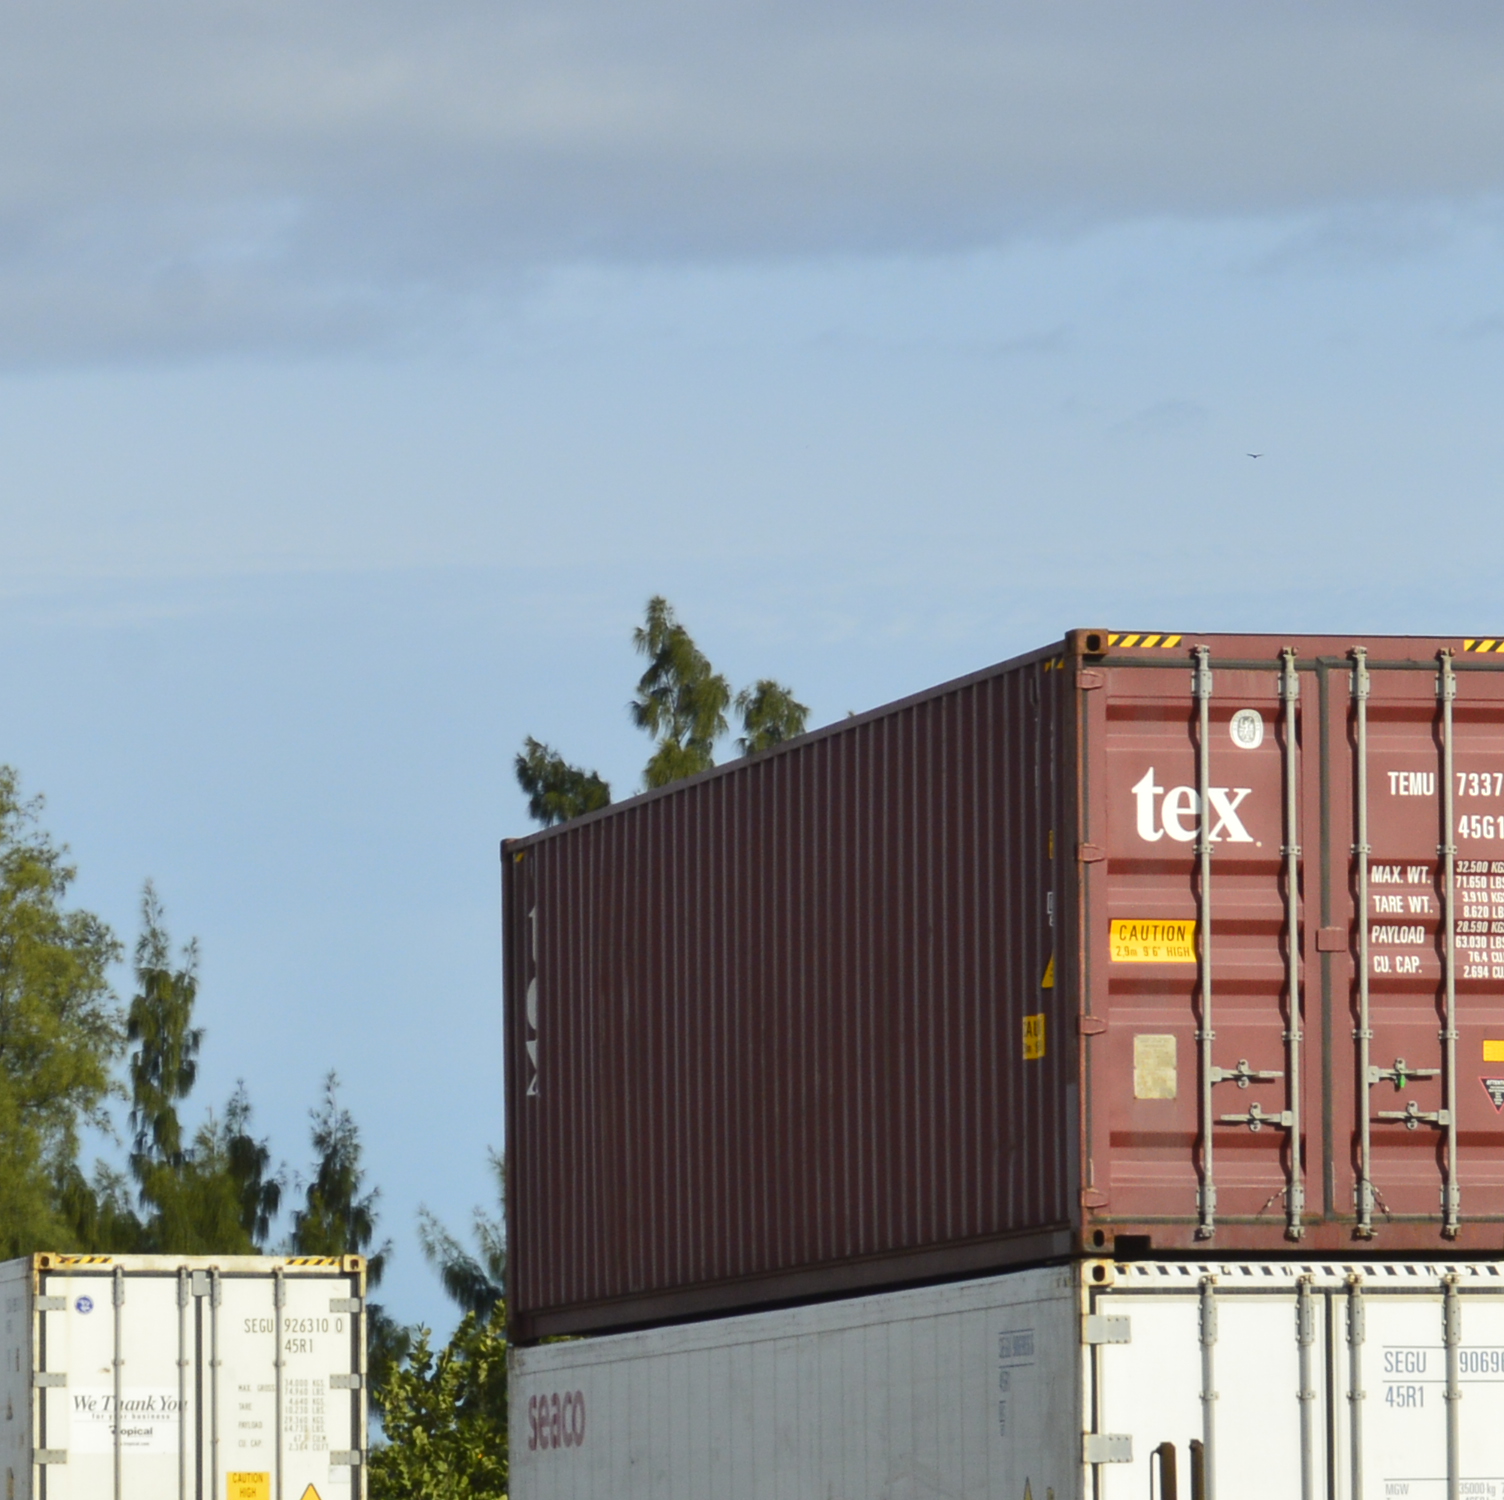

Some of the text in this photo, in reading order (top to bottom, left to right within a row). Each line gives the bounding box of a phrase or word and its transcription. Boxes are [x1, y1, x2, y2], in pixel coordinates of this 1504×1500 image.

[1387, 771, 1435, 796] TEMU
[1131, 766, 1254, 842] tex
[1371, 865, 1431, 884] MAX. WT.
[1456, 861, 1488, 873] 32.500
[1455, 875, 1487, 889] 71.650
[1373, 895, 1433, 913] TARE WT.
[1462, 891, 1488, 903] 3.910
[1463, 905, 1489, 919] 8.620
[1118, 924, 1187, 942] CAUTION
[1456, 920, 1488, 933] 28.590
[1371, 925, 1426, 944] PAYLOAD
[1455, 935, 1487, 949] 63.030
[1166, 946, 1191, 958] HIGH
[1467, 951, 1488, 962] 76.4
[1373, 955, 1423, 973] CU. CAP.
[1463, 965, 1489, 978] 2.694
[244, 1318, 274, 1333] SEGU
[284, 1318, 329, 1333] 926310
[284, 1338, 313, 1353] 45R1
[1384, 1350, 1427, 1373] SEGU
[73, 1394, 97, 1412] We
[1385, 1385, 1425, 1408] 45R1
[528, 1390, 586, 1451] seaco
[232, 1472, 263, 1483] CAUTION
[239, 1487, 256, 1498] HIGH
[1385, 1483, 1409, 1495] MGW
[1459, 1482, 1485, 1494] 35000
[1486, 1482, 1496, 1496] kg
